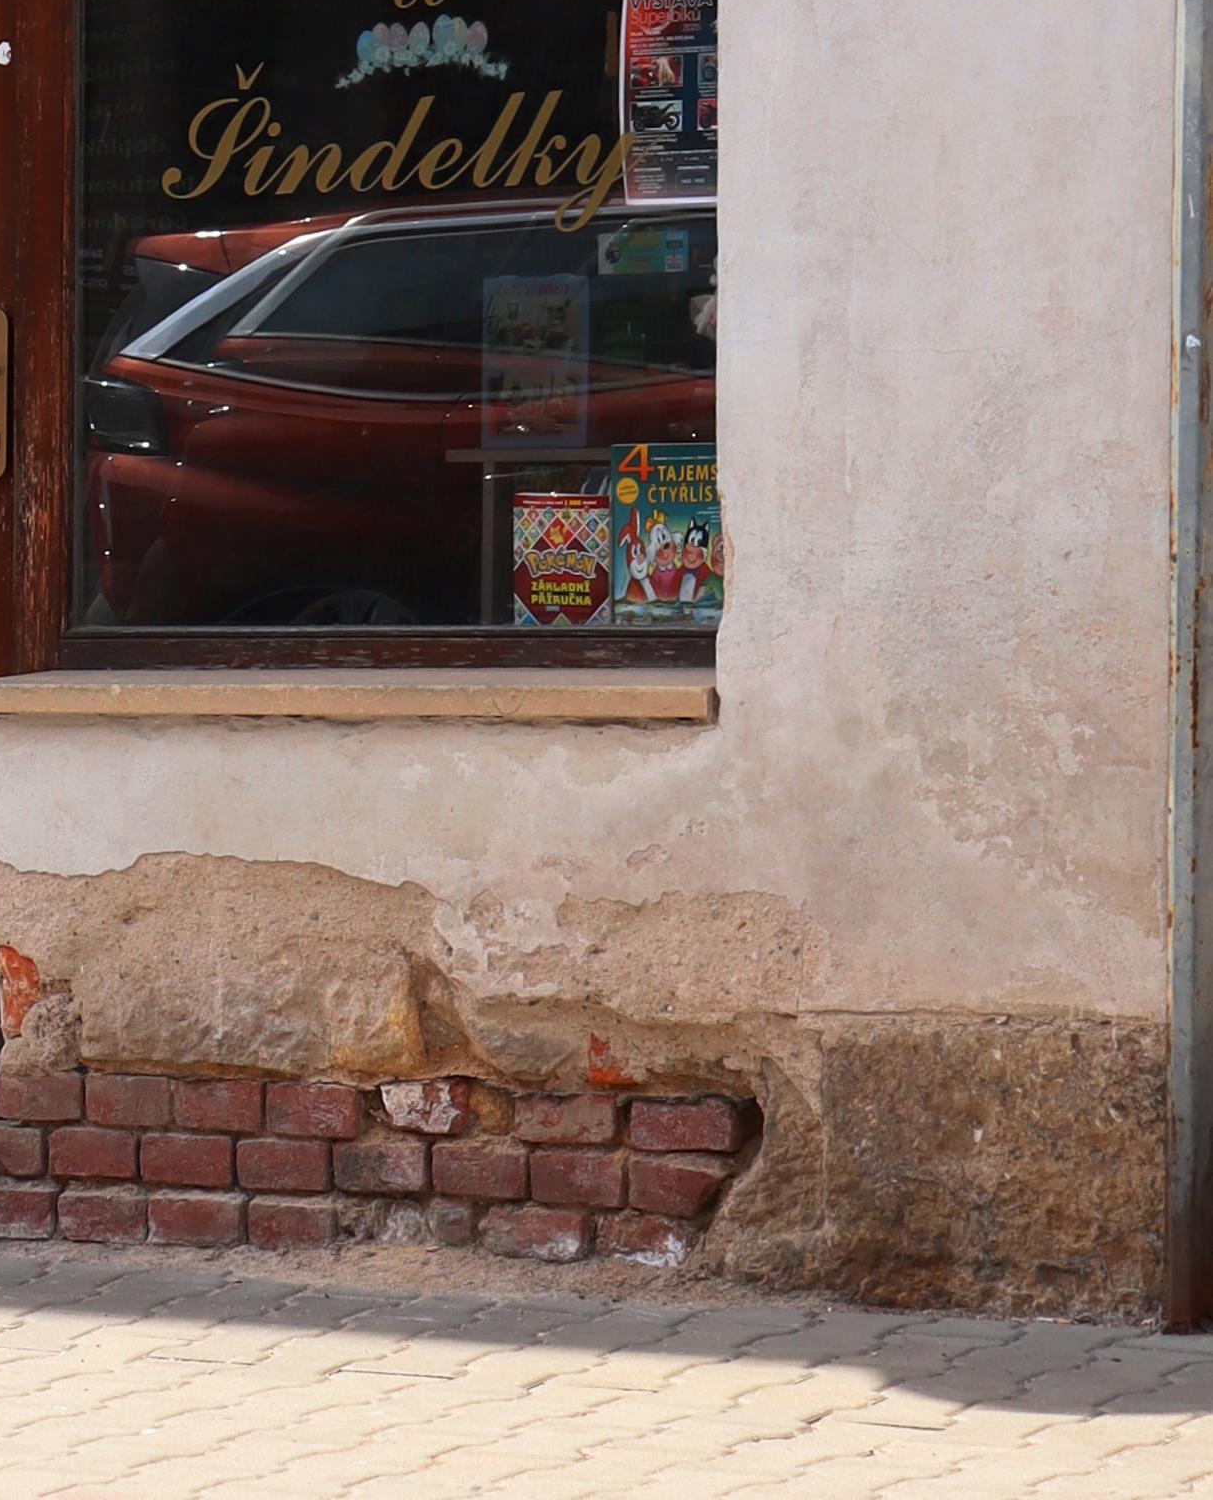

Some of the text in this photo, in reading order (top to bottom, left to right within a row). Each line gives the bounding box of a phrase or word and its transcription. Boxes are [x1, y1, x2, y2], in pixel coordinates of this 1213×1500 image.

[162, 61, 663, 233] Šindelky
[617, 444, 655, 482] 4
[648, 483, 721, 503] ČTYŘLÍS
